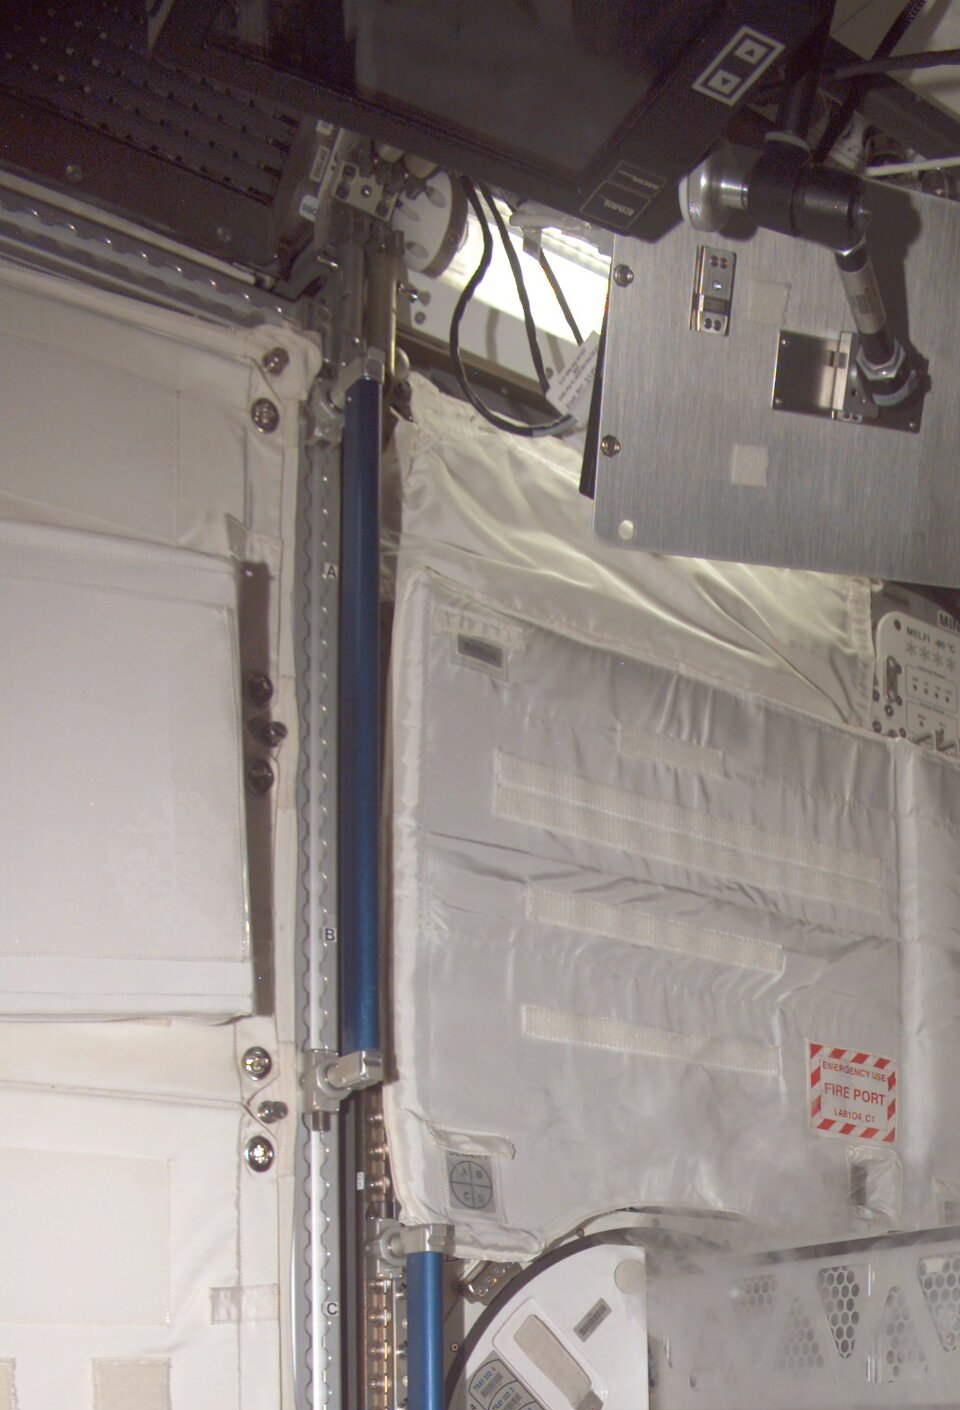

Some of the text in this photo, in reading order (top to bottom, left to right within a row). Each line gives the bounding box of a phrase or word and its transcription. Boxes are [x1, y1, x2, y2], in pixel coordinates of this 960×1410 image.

[327, 565, 337, 578] A
[325, 928, 335, 941] B
[822, 1061, 887, 1083] EMERGENCY USE
[824, 1082, 886, 1106] FIRE PORT
[327, 1302, 338, 1315] C
